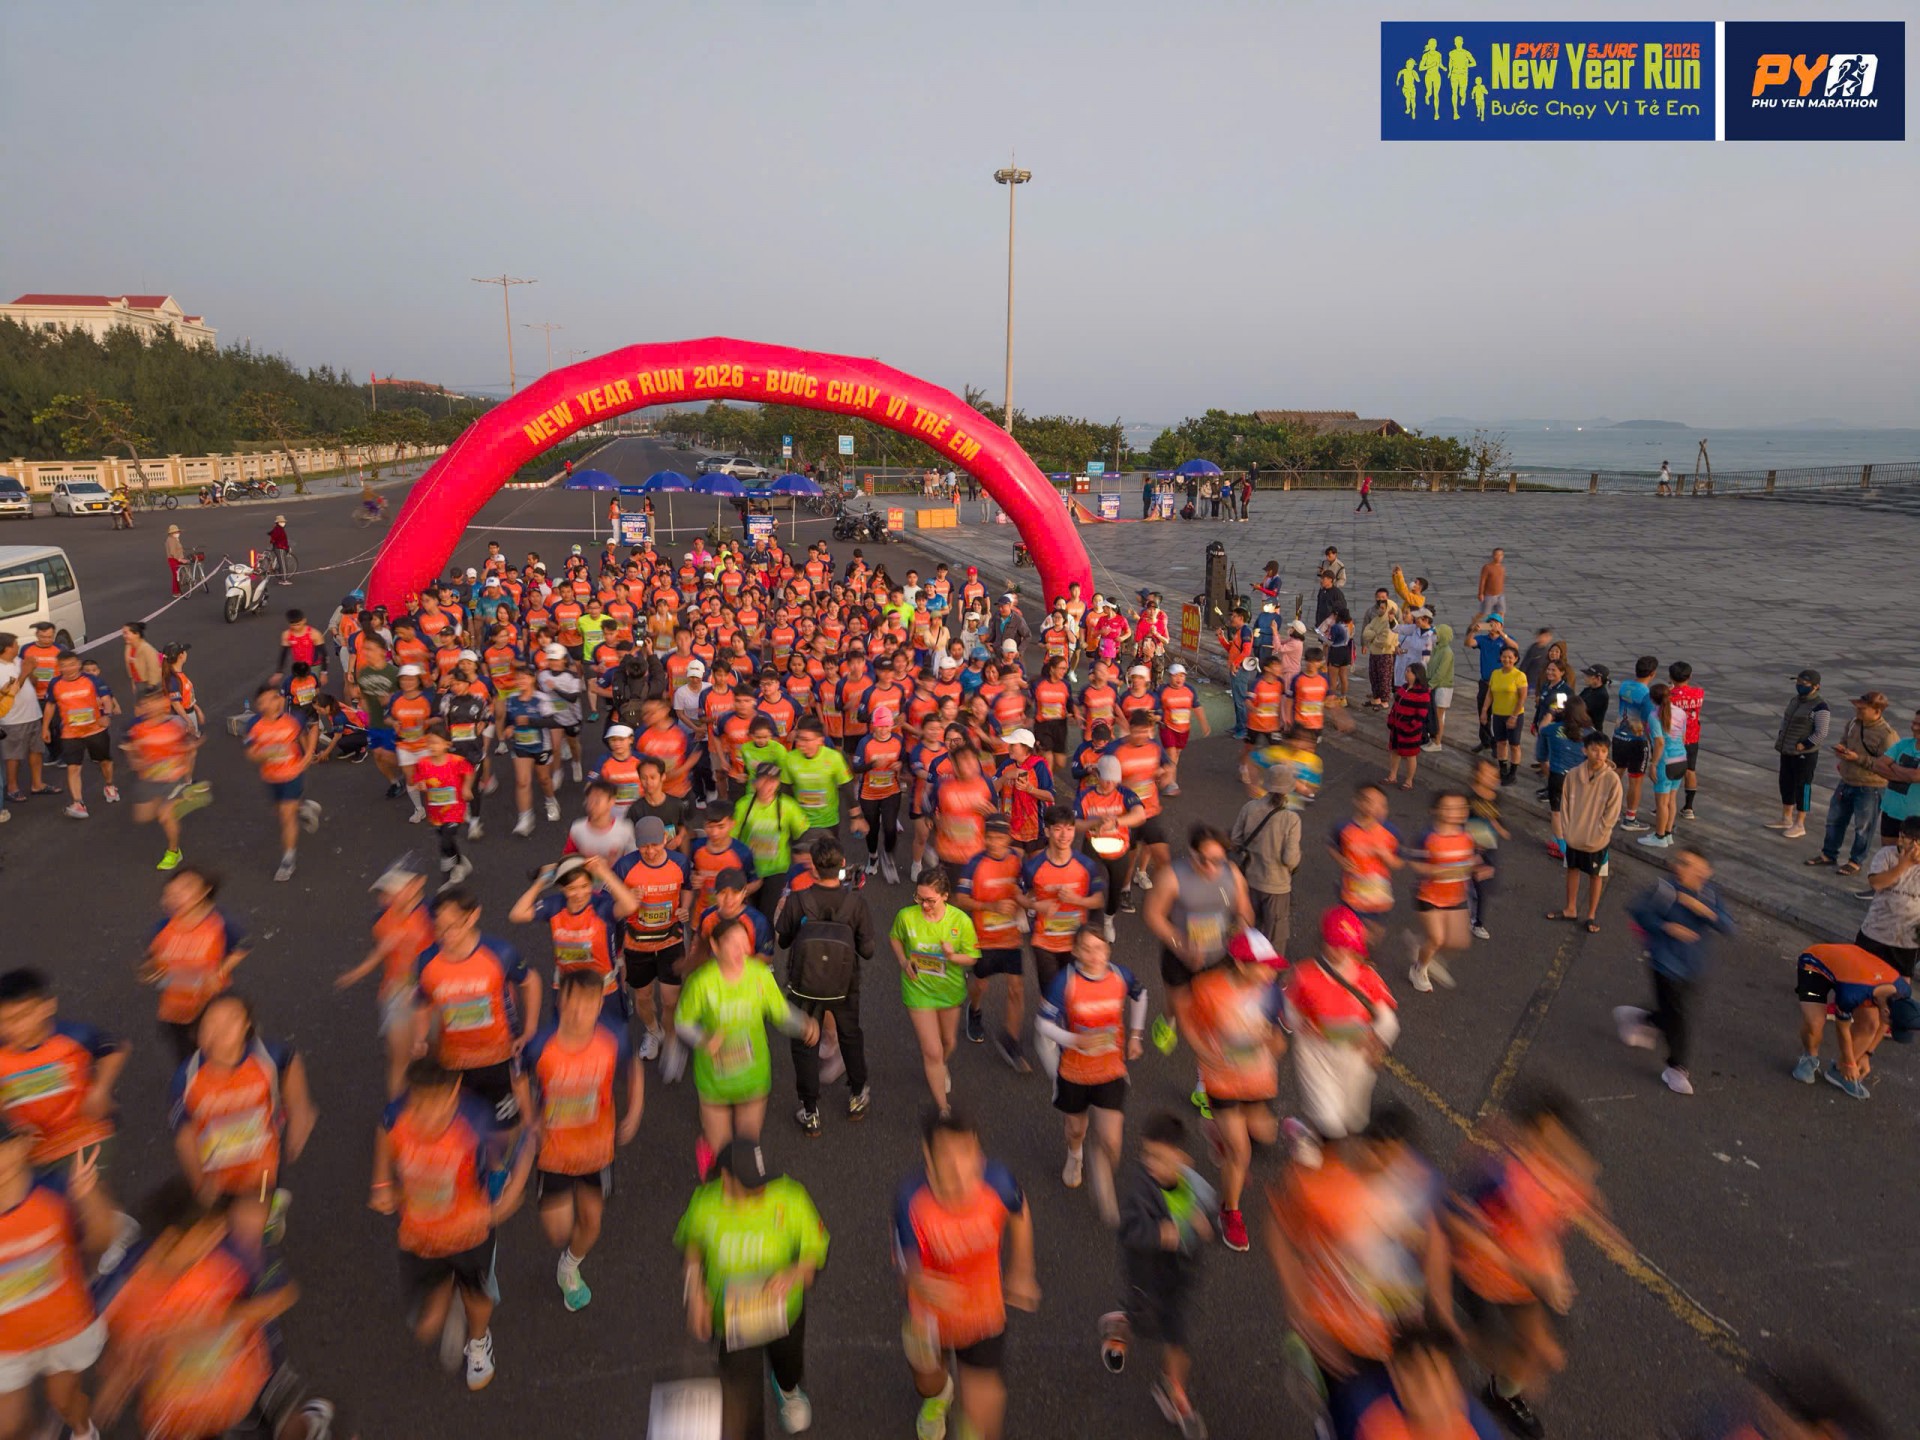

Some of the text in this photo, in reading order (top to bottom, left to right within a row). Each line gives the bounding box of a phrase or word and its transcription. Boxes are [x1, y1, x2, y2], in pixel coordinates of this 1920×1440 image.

[522, 401, 574, 446] NEW
[576, 378, 634, 415] YEAR
[637, 368, 685, 396] RUN
[693, 364, 743, 389] 2026
[766, 368, 818, 398] BƯỚC
[826, 380, 881, 410] CHẠY
[886, 395, 910, 421] VÌ
[911, 413, 953, 440] TRẺ
[947, 429, 982, 462] EM
[784, 436, 791, 445] P
